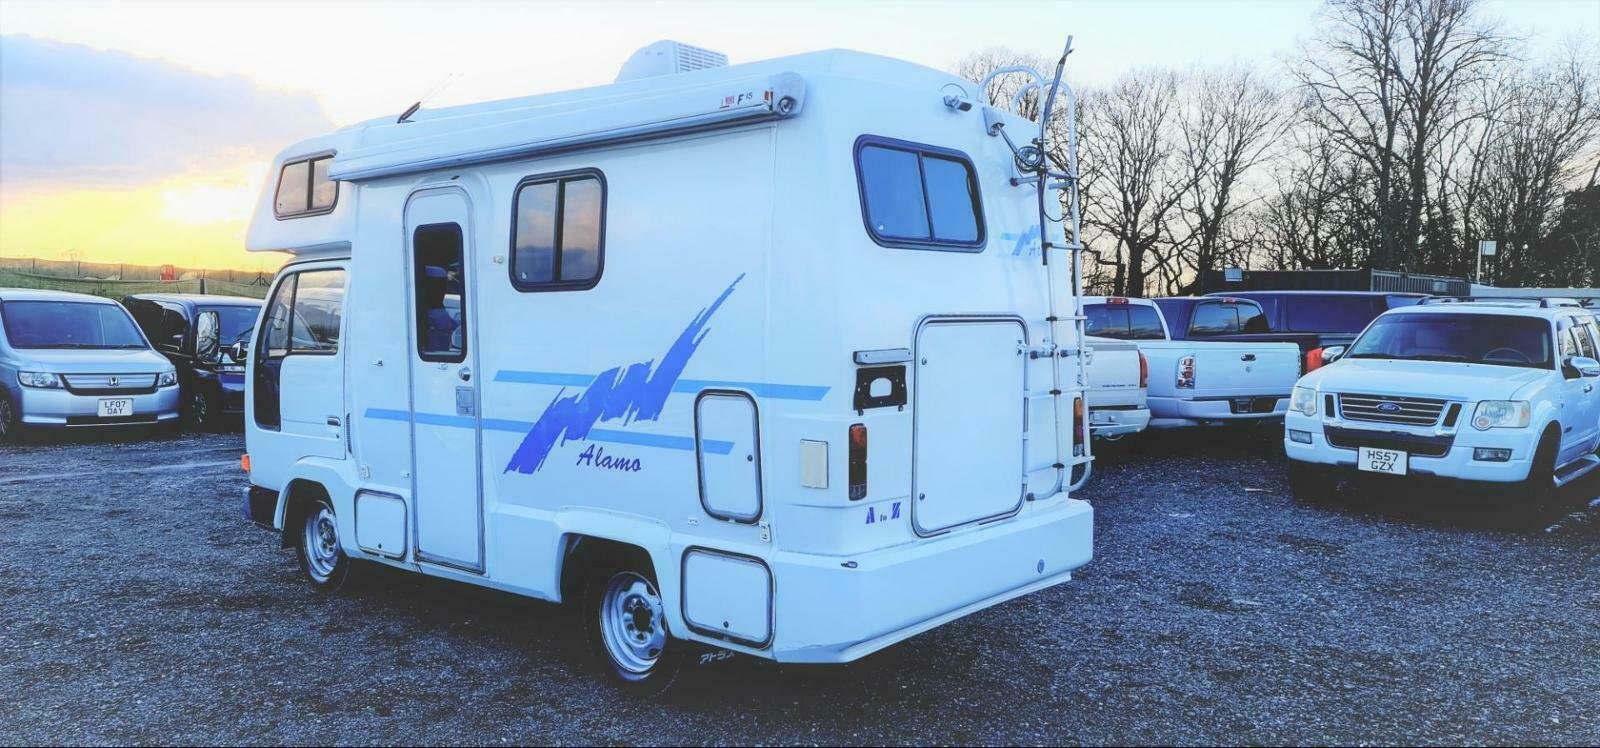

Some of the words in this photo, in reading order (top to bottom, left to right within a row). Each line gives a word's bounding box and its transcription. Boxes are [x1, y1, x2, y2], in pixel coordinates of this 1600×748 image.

[737, 94, 744, 104] F
[104, 400, 126, 408] LF07
[576, 443, 642, 472] Alamo
[1367, 450, 1399, 462] HS57
[1371, 460, 1395, 471] GZX
[865, 506, 875, 524] A
